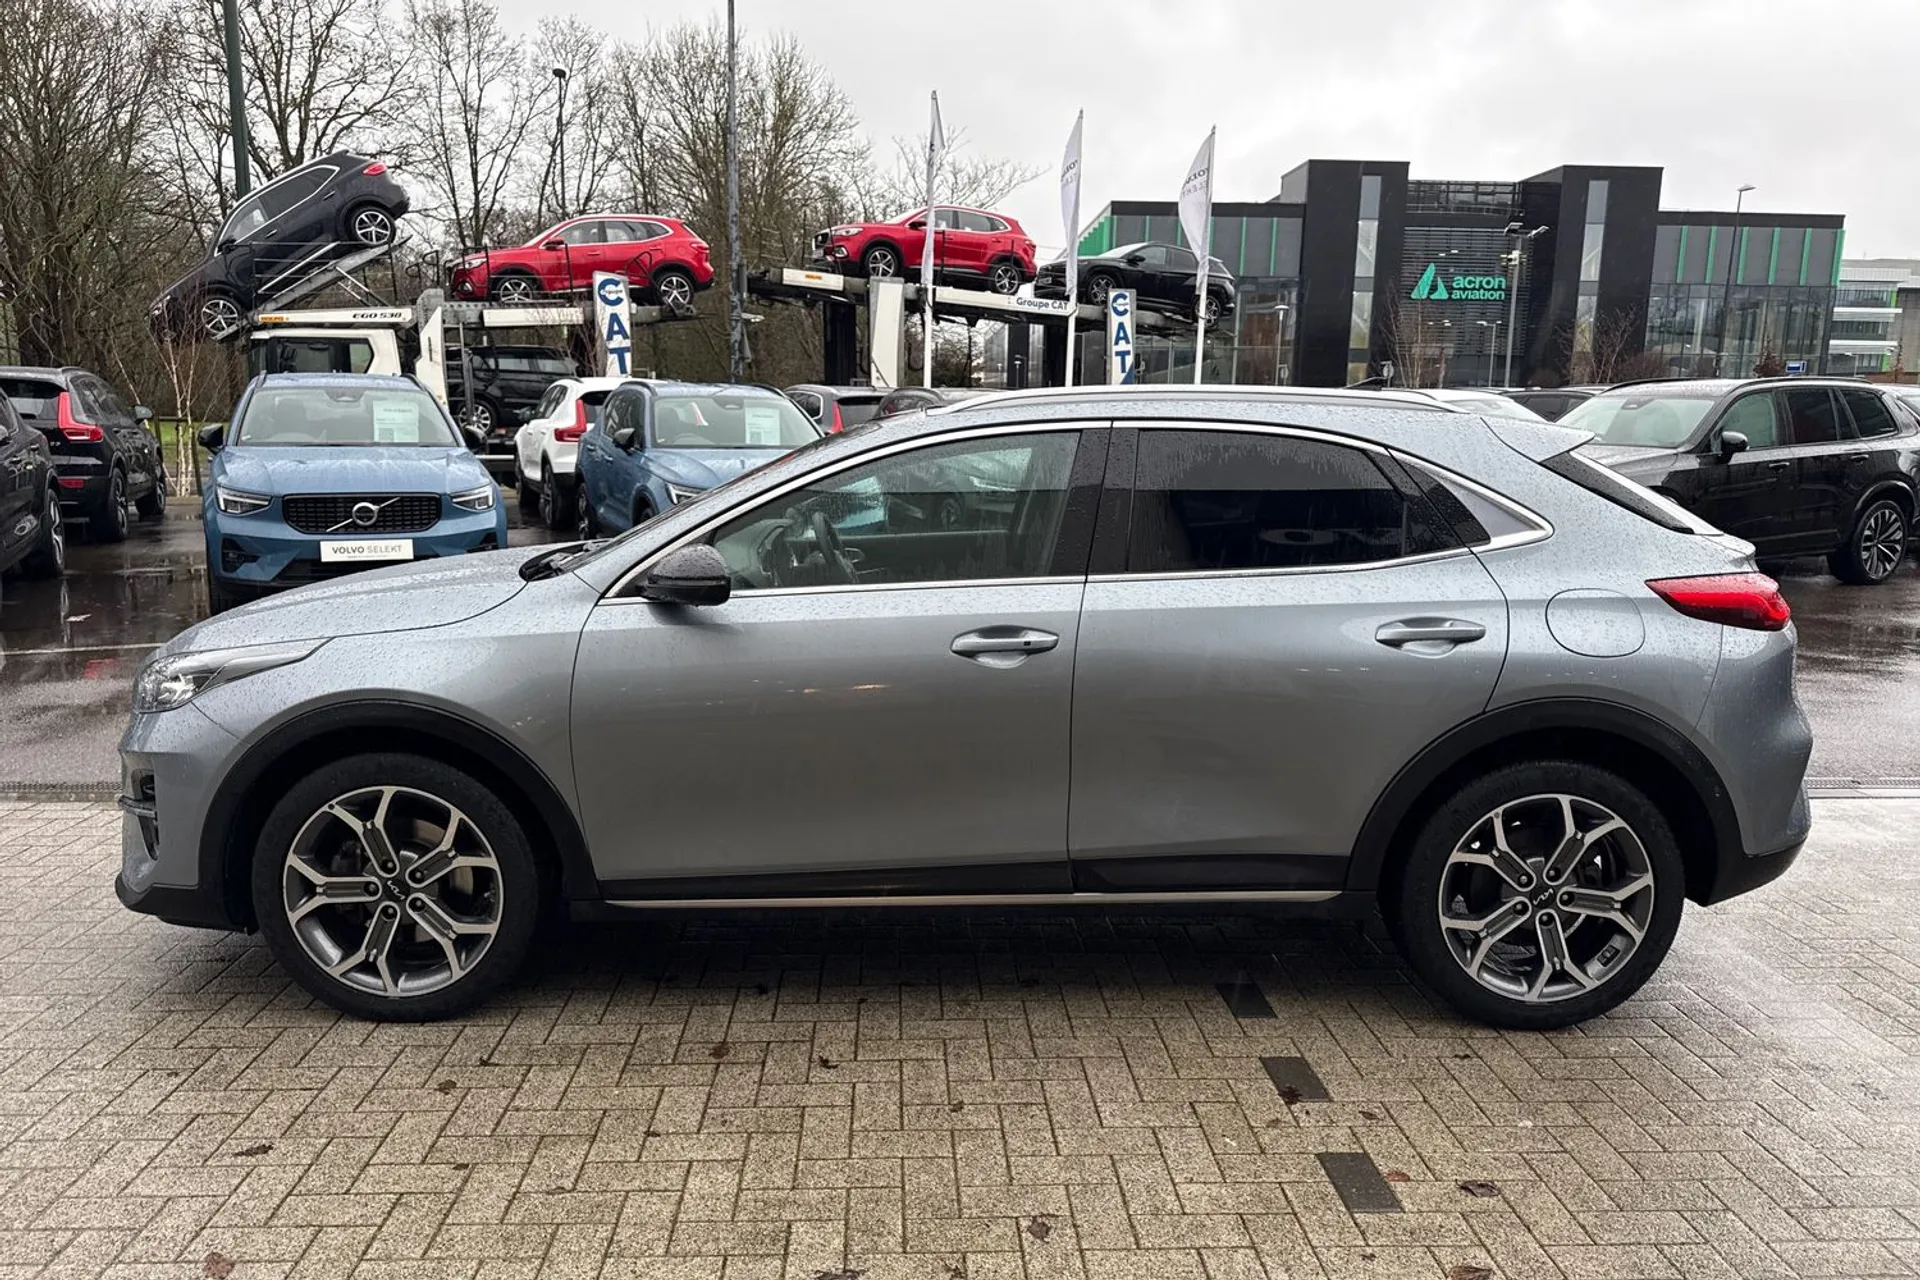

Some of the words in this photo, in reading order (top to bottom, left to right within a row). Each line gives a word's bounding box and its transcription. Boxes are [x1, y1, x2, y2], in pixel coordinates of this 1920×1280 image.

[1452, 276, 1506, 289] acron
[1451, 288, 1506, 300] aviation
[1016, 297, 1050, 310] Groupe
[1051, 300, 1068, 310] CAT
[598, 278, 631, 375] CAT
[1111, 293, 1131, 374] CAT
[332, 546, 365, 554] VOLVO
[366, 544, 403, 554] SELEKT
